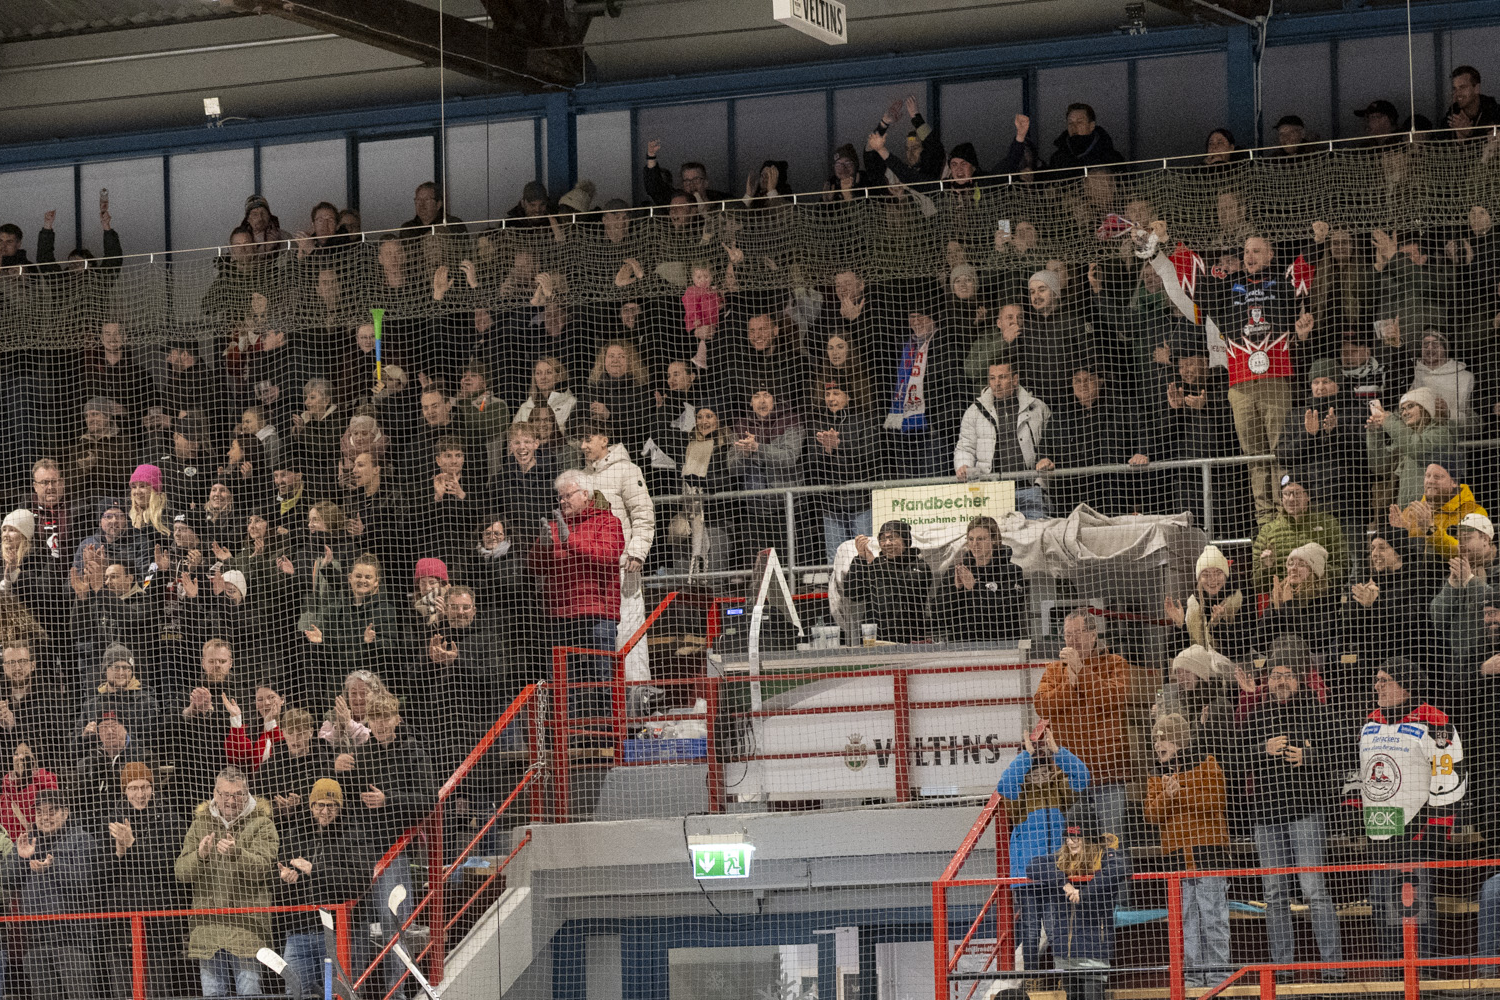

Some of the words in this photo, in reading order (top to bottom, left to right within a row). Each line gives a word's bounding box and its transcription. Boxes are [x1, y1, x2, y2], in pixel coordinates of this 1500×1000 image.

[803, 0, 843, 37] VELTINS
[891, 495, 990, 512] Pfandbecher
[873, 734, 1000, 769] VLTINS
[1367, 812, 1395, 825] AOK
